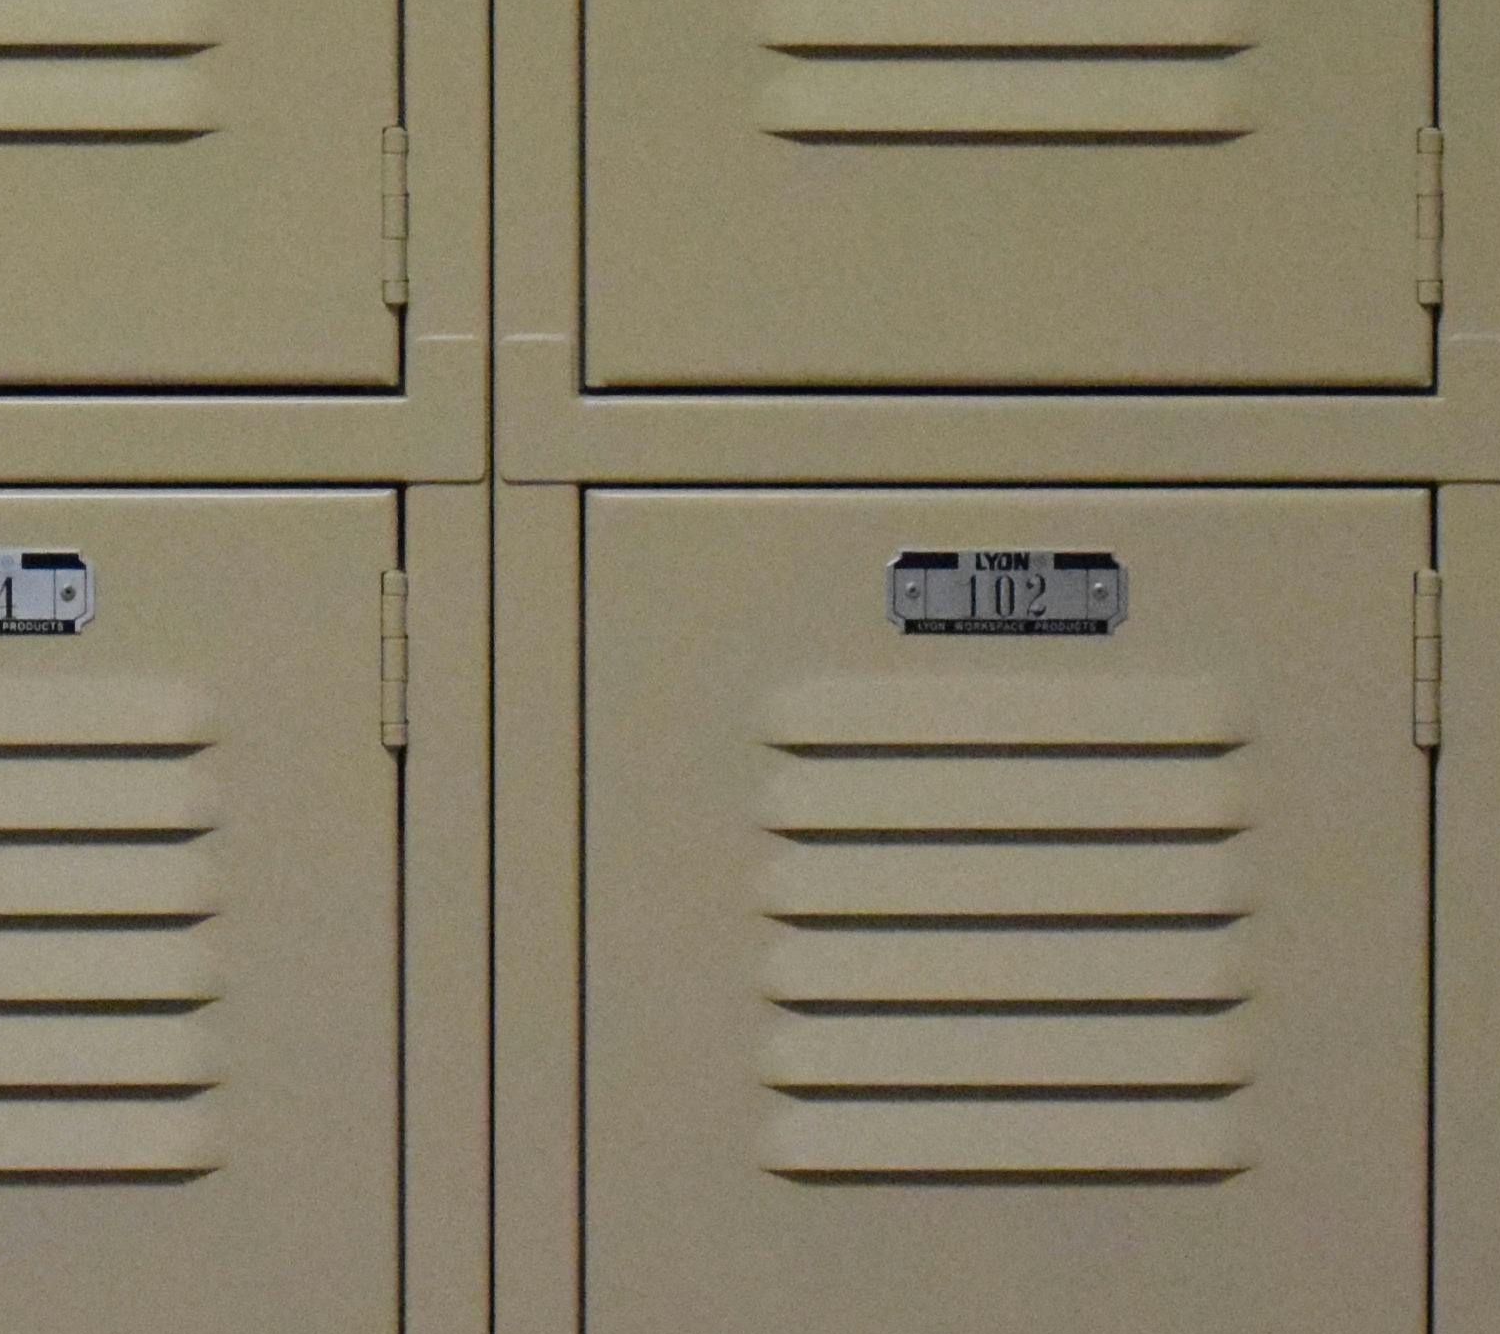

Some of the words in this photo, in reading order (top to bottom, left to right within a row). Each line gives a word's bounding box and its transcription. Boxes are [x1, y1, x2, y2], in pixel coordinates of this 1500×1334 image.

[976, 552, 1030, 571] LYON
[957, 573, 1046, 617] 102
[2, 620, 64, 631] PRODUCTS
